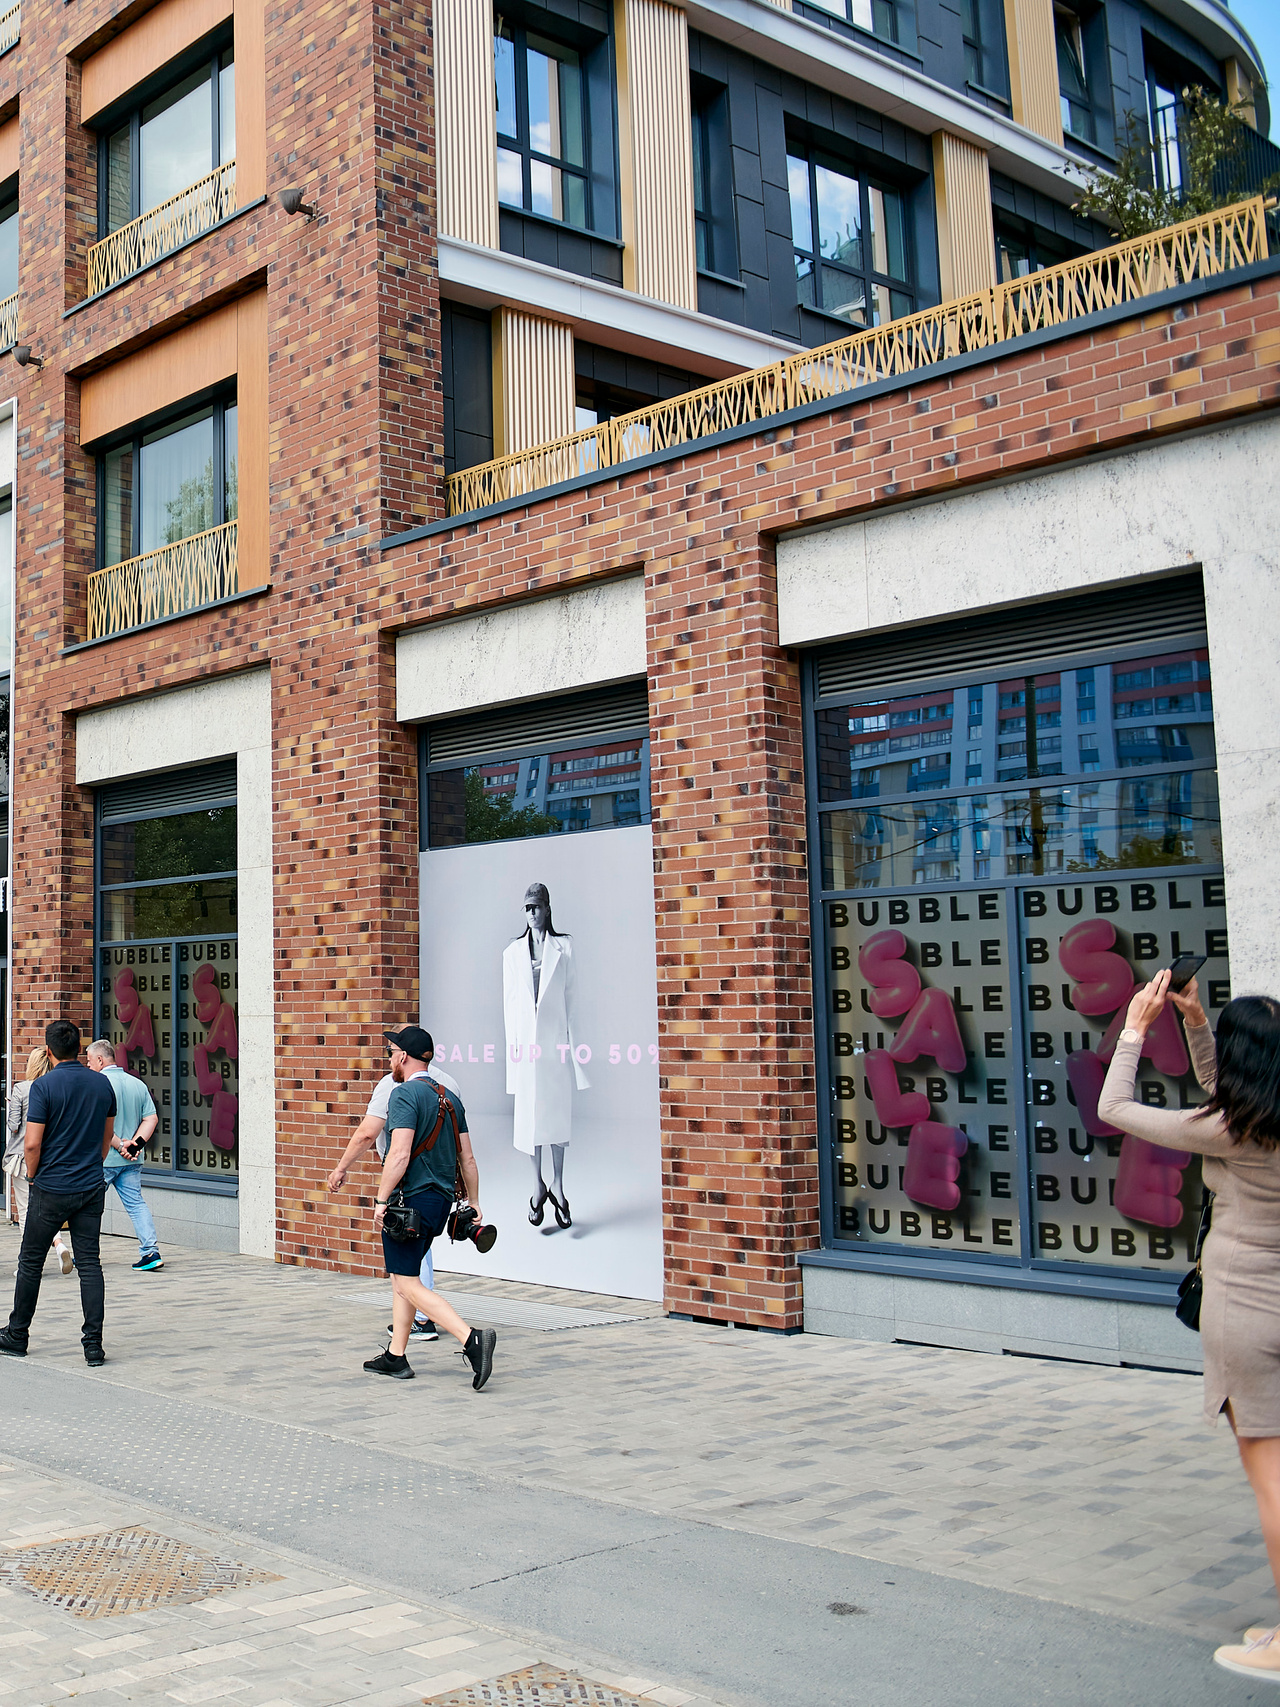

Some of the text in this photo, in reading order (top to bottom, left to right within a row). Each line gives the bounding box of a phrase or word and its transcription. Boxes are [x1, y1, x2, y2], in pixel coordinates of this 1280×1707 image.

[829, 893, 1000, 928] BUBBLE
[1023, 878, 1226, 918] BUBBLE
[102, 946, 170, 966] BUBBLE
[831, 939, 1002, 971] BBLE
[1026, 929, 1229, 965] BBLE
[102, 974, 170, 993] BBLE
[434, 1043, 495, 1063] SALE
[510, 1043, 542, 1064] UP
[556, 1043, 592, 1065] TO
[839, 1205, 1013, 1246] BUBBLE
